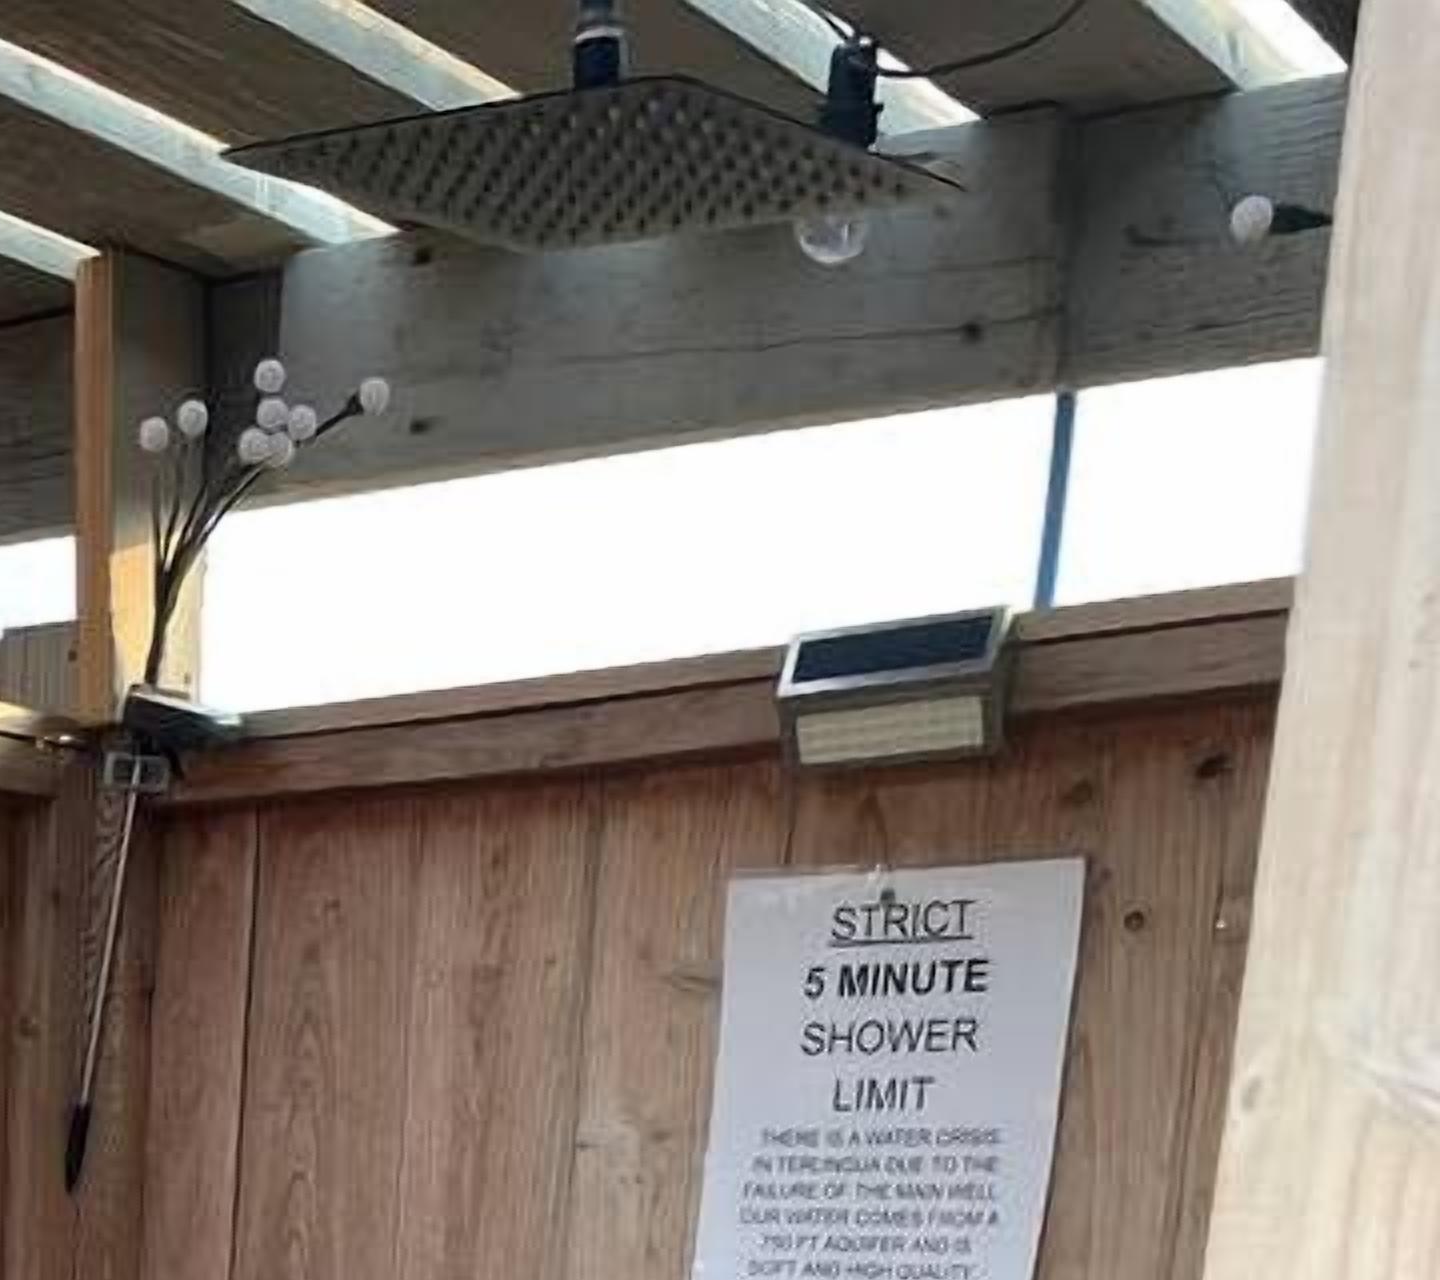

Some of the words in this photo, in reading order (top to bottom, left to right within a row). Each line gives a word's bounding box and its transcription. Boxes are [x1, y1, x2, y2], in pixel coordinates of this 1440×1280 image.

[830, 900, 975, 945] STRICT
[803, 966, 825, 1000] 5
[839, 959, 990, 998] MINUTE
[800, 1018, 978, 1056] SHOWER
[833, 1077, 936, 1112] LIMIT
[848, 1128, 860, 1147] A
[910, 1236, 949, 1253] AND
